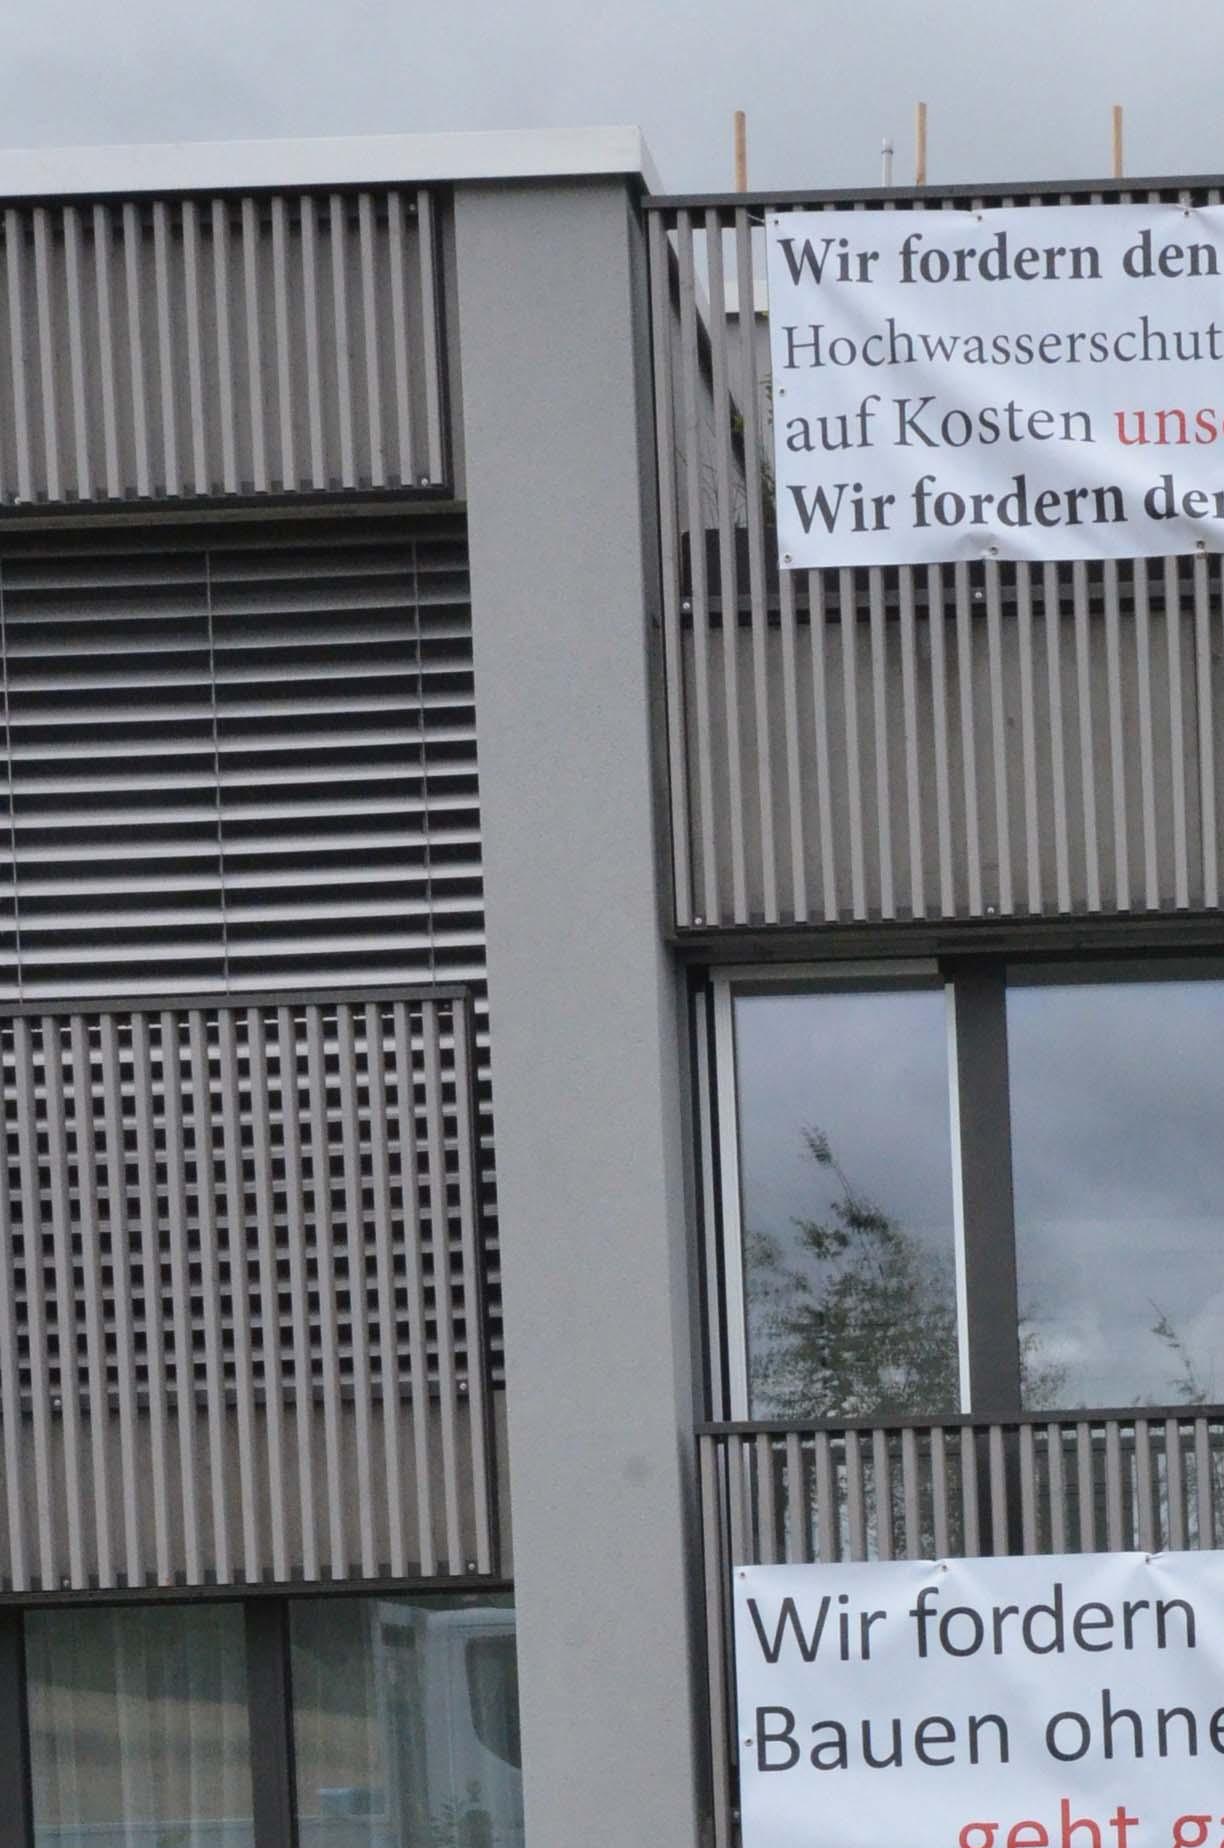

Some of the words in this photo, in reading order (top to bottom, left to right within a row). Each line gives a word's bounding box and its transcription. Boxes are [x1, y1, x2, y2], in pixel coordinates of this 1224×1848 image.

[777, 237, 880, 287] Wir
[899, 230, 1103, 284] fordern
[1123, 228, 1221, 279] den
[786, 394, 882, 453] auf
[891, 395, 1096, 449] Kosten
[786, 482, 896, 535] Wir
[911, 473, 1129, 530] fordern
[746, 1593, 888, 1664] Wir
[909, 1582, 1197, 1659] fordern
[756, 1705, 1010, 1773] Bauen
